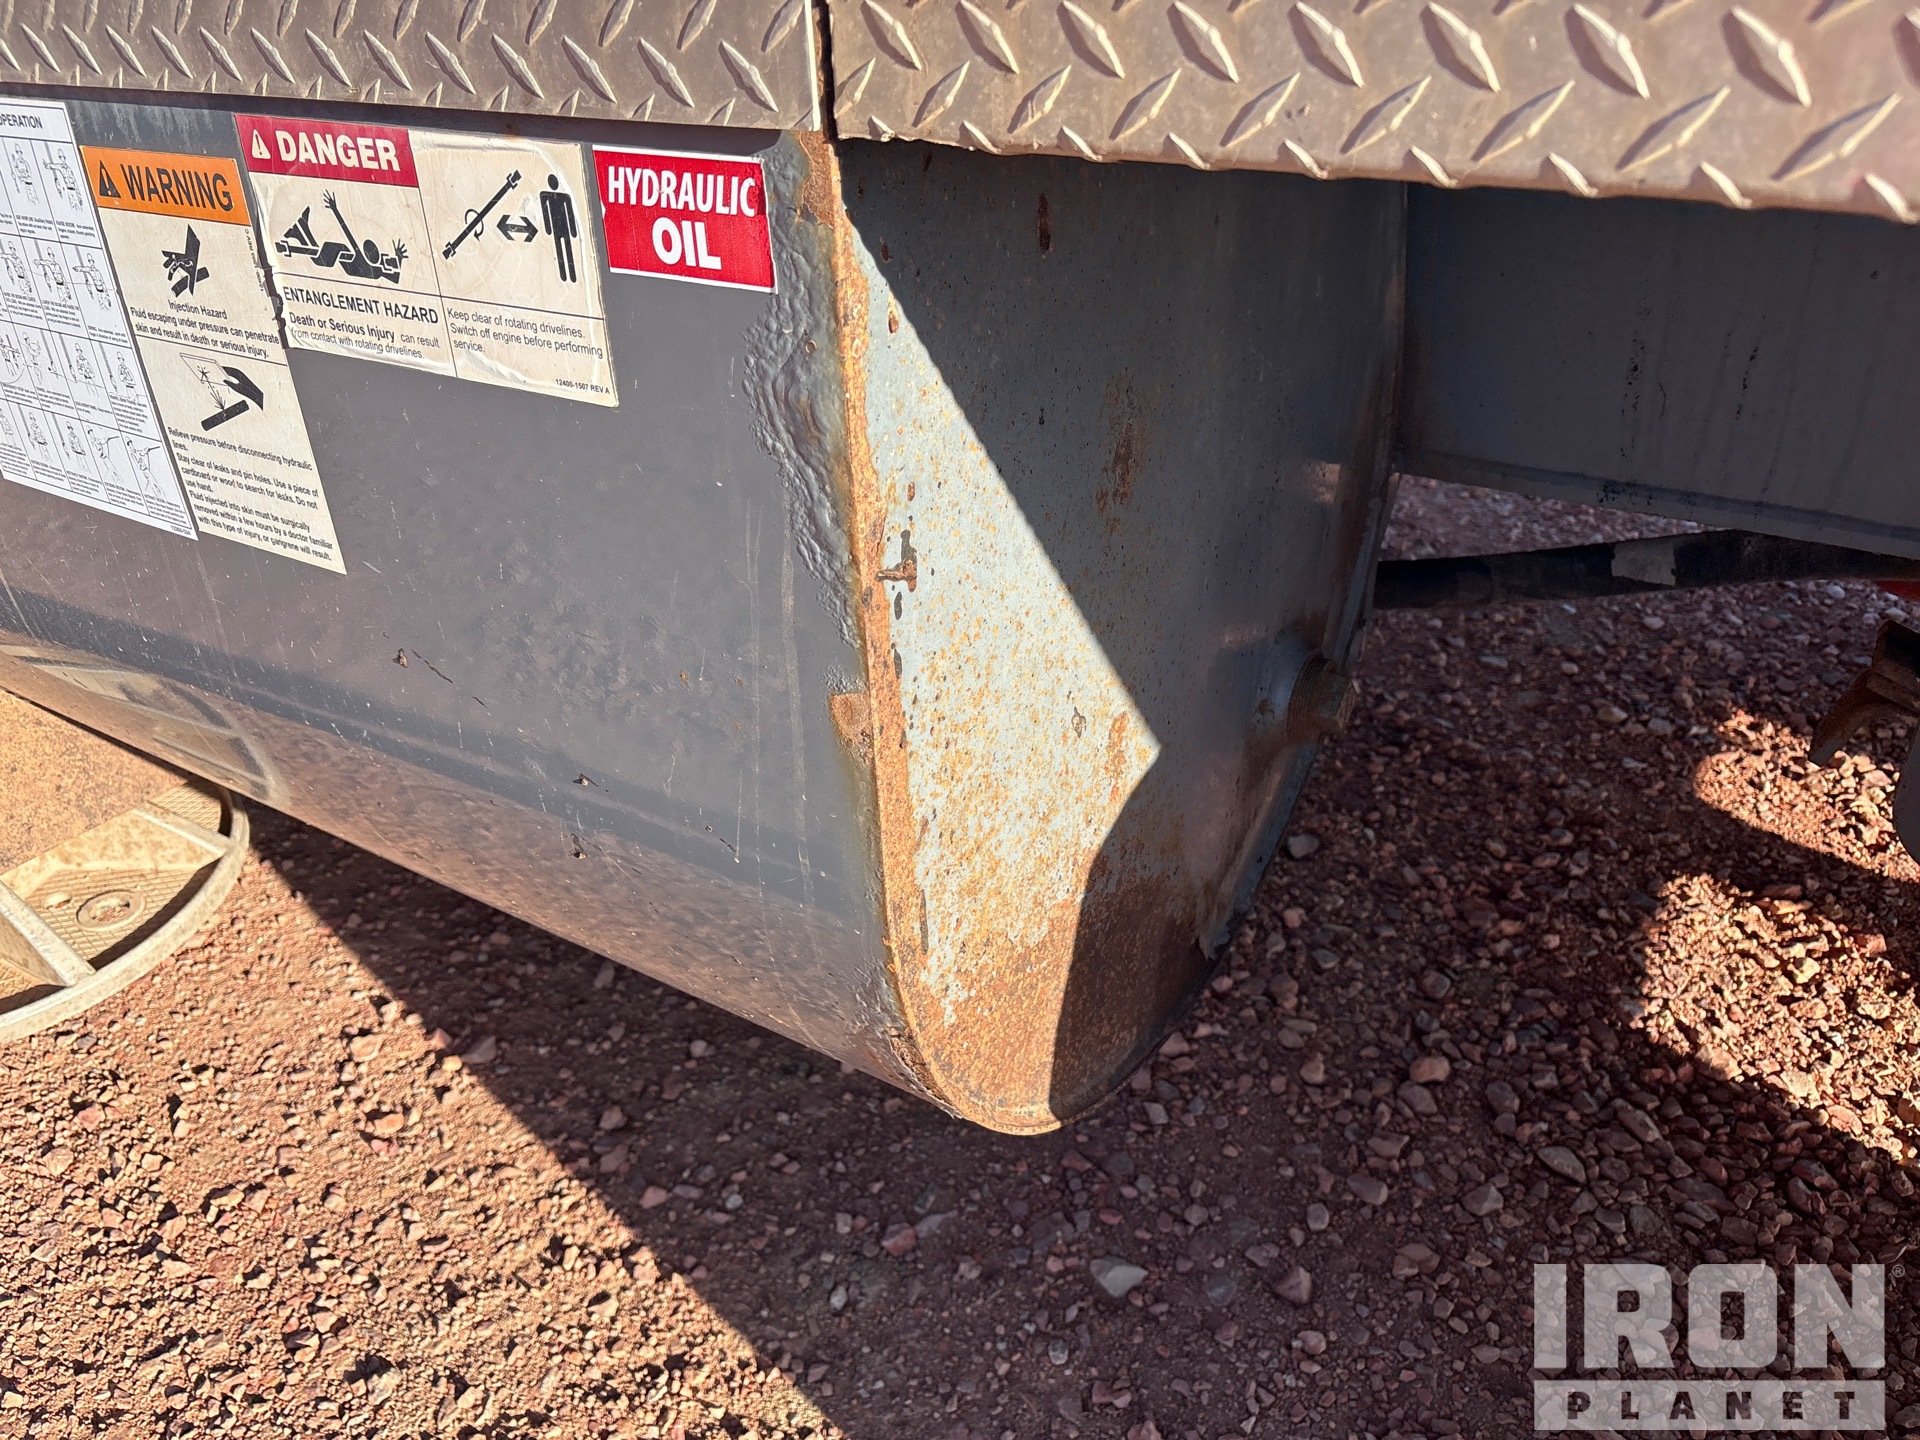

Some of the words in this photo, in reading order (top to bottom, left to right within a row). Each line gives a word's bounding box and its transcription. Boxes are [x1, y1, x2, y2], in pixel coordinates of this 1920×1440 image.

[275, 130, 401, 171] DANGER
[120, 164, 234, 212] WARNING
[608, 165, 756, 217] HYDRAULIC
[652, 217, 722, 270] OIL
[168, 299, 200, 315] Injection
[200, 305, 228, 320] Hazard
[283, 286, 380, 315] ENTANGLEMENT
[383, 301, 439, 324] HAZARD
[447, 307, 470, 323] Keep
[471, 311, 492, 324] clear
[493, 314, 504, 326] of
[505, 317, 538, 334] rotating
[539, 322, 586, 339] drivelines.
[130, 306, 146, 319] Fluid
[147, 311, 178, 327] escaping
[178, 317, 197, 329] under
[198, 322, 229, 335] pressure
[230, 327, 244, 337] can
[244, 330, 280, 345] penetrate
[134, 322, 149, 332] skin
[149, 326, 163, 336] and
[163, 328, 182, 340] result
[182, 331, 190, 341] in
[190, 333, 211, 346] death
[211, 339, 219, 347] or
[219, 339, 246, 353] serious
[246, 343, 269, 359] injury.
[289, 312, 316, 327] Death
[318, 319, 327, 329] or
[328, 318, 366, 336] Serious
[367, 325, 395, 343] Injury
[400, 333, 415, 344] can
[417, 336, 440, 348] result
[290, 327, 309, 339] from
[310, 332, 337, 344] contact
[338, 336, 355, 347] with
[355, 339, 383, 355] rotating
[385, 343, 425, 359] drivelines.
[450, 323, 479, 337] Switch
[479, 328, 492, 339] off
[492, 331, 522, 345] engine
[523, 335, 553, 349] before
[554, 341, 603, 359] performing
[453, 338, 486, 353] service.
[590, 384, 604, 393] REV
[605, 386, 610, 394] A
[167, 426, 190, 440] Relieve
[190, 434, 217, 447] pressure
[216, 439, 237, 452] before
[238, 445, 282, 465] disconnecting
[282, 455, 313, 471] hydraulic
[176, 452, 191, 465] Stay
[190, 456, 205, 468] clear
[206, 460, 213, 469] of
[212, 462, 230, 474] leaks
[230, 468, 243, 477] and
[242, 471, 254, 480] pin
[253, 472, 273, 486] holes.
[273, 477, 287, 489] Use
[287, 483, 293, 491] a
[292, 484, 311, 496] piece
[311, 489, 319, 498] of
[181, 467, 212, 481] cardboard
[244, 483, 266, 496] search
[265, 488, 275, 498] for
[275, 490, 295, 504] leaks.
[295, 495, 306, 507] Do
[307, 501, 318, 510] not
[193, 504, 219, 517] removed
[219, 510, 238, 522] within
[238, 516, 243, 524] a
[242, 516, 255, 527] few
[254, 520, 273, 533] hours
[273, 525, 282, 537] by
[282, 529, 287, 537] a
[288, 530, 309, 543] doctor
[309, 535, 333, 550] familiar
[204, 494, 229, 508] injected
[228, 500, 241, 512] into
[241, 505, 255, 516] skin
[254, 510, 271, 521] must
[270, 512, 280, 523] be
[280, 517, 310, 533] surgically
[222, 522, 236, 533] type
[262, 535, 269, 543] or
[270, 537, 300, 552] gangrene
